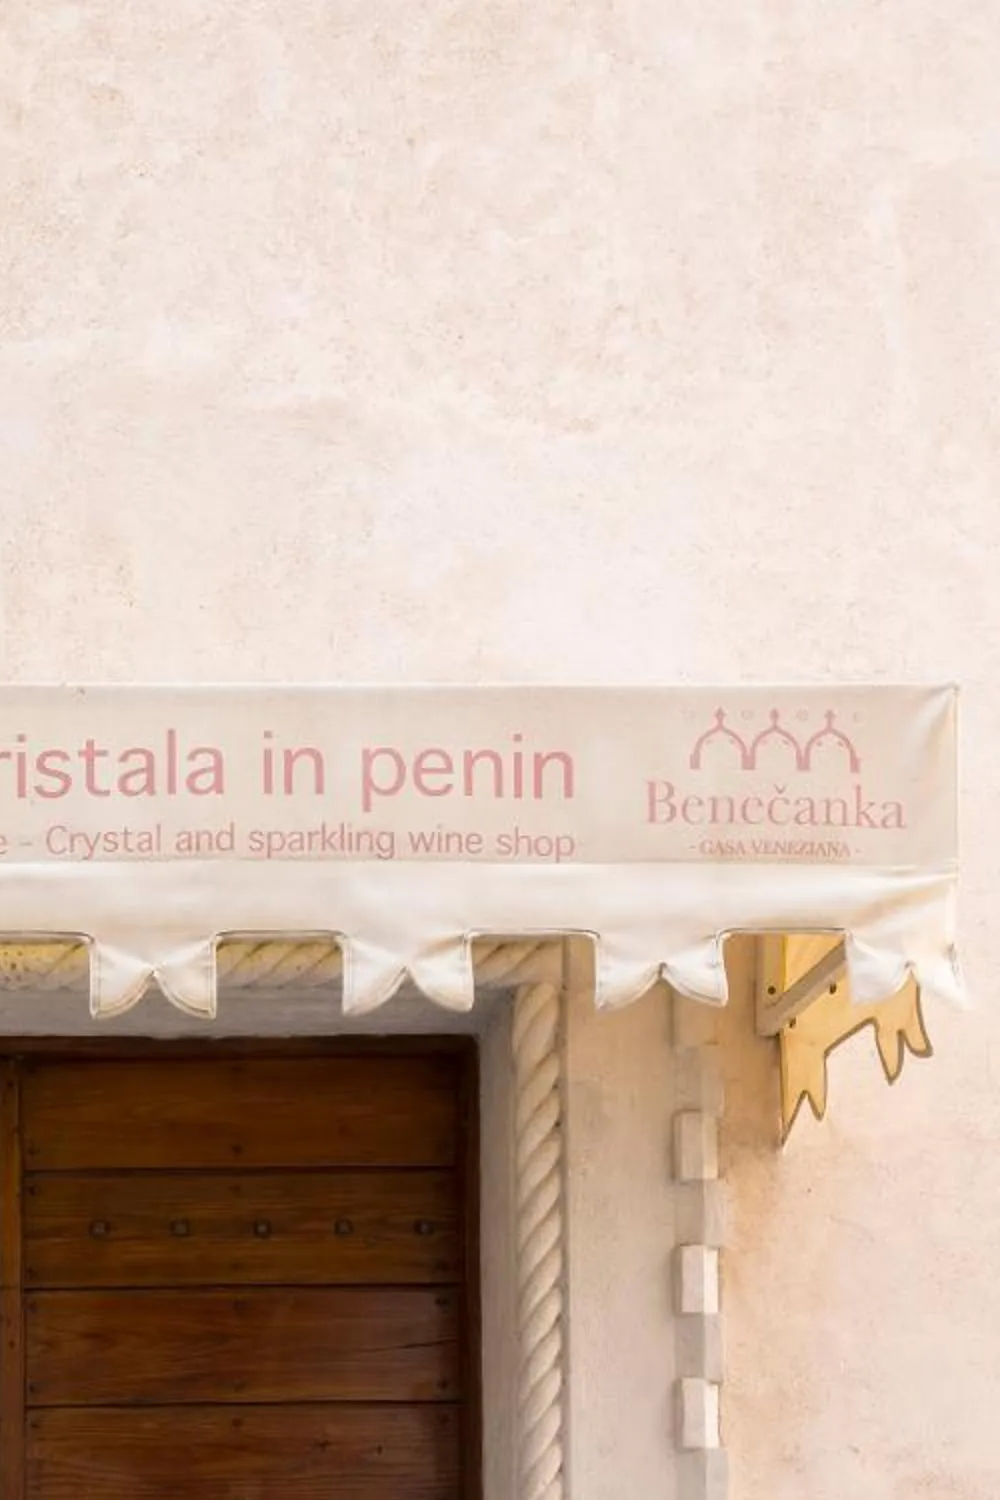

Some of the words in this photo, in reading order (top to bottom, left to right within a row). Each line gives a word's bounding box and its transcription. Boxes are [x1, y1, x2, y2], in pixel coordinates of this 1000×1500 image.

[262, 730, 326, 797] in
[361, 733, 575, 813] penin
[646, 779, 908, 830] Benečanka
[45, 822, 163, 861] Crystal
[174, 821, 236, 853] and
[247, 822, 397, 861] sparkling
[406, 823, 484, 856] wine
[494, 825, 576, 864] shop
[699, 838, 746, 857] CASA
[751, 839, 851, 859] VENEZIANA
